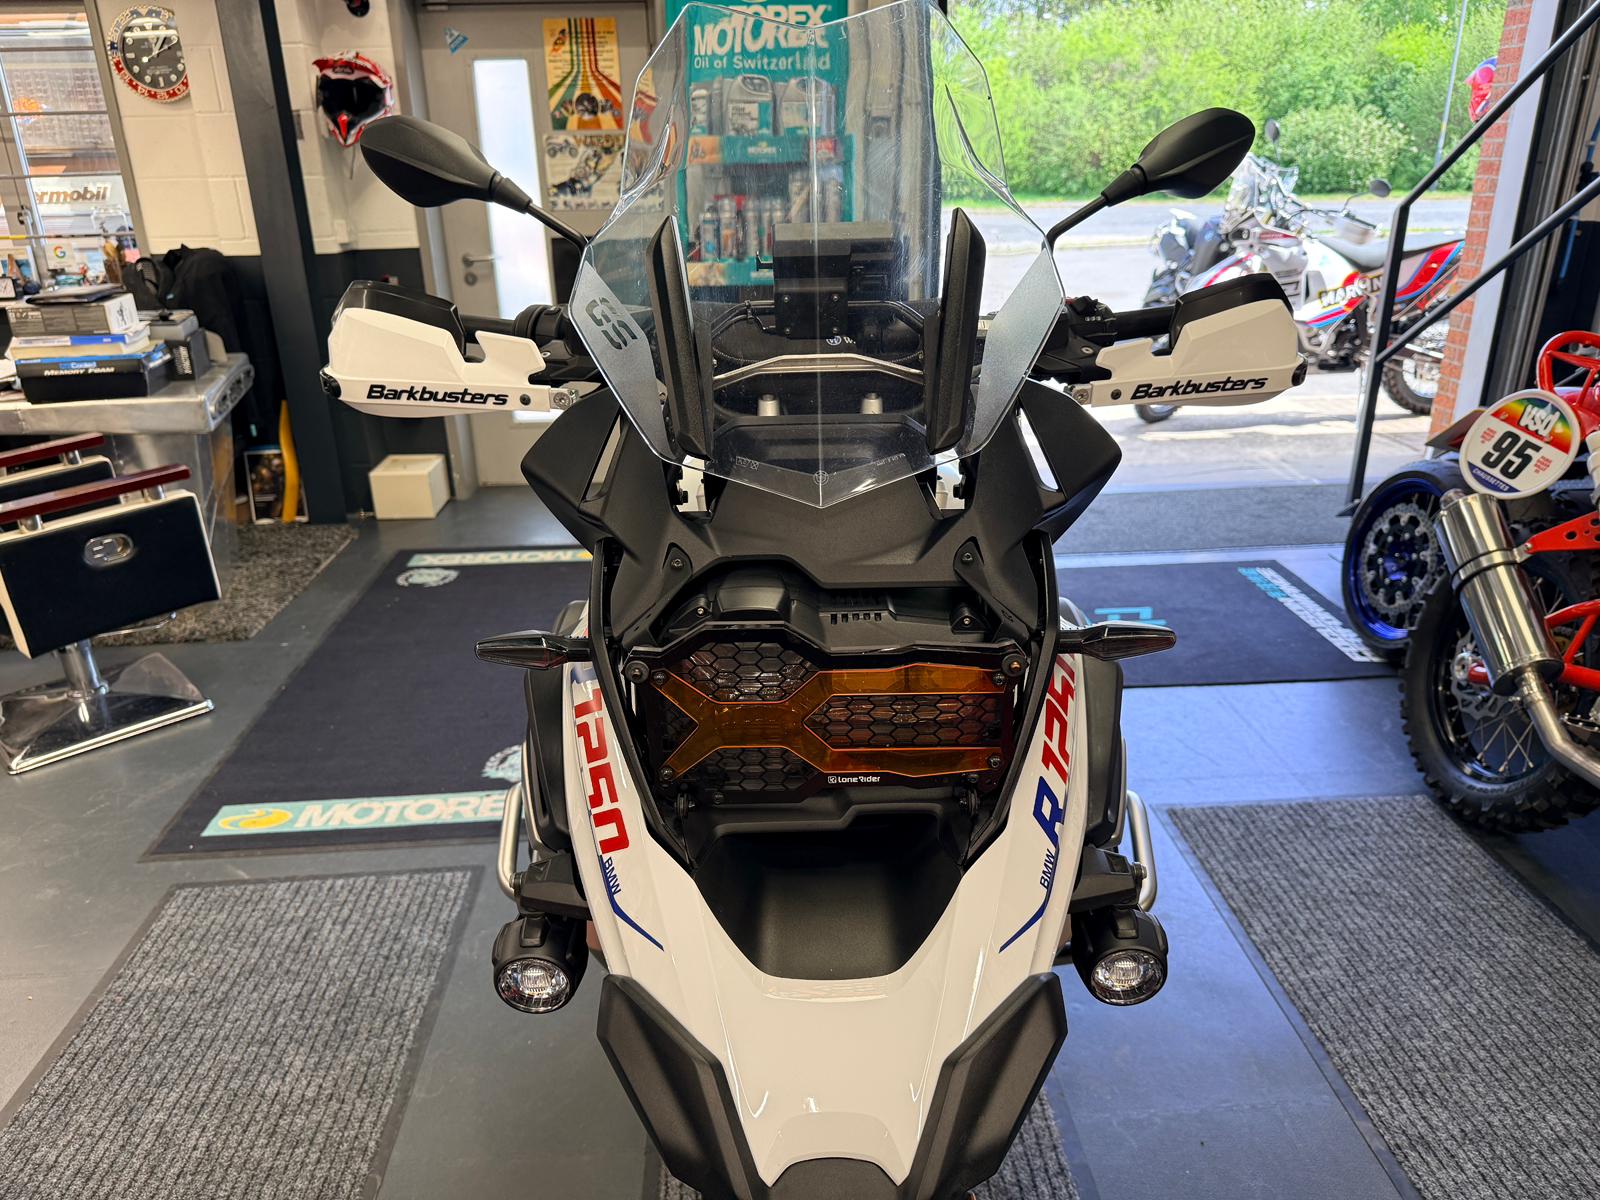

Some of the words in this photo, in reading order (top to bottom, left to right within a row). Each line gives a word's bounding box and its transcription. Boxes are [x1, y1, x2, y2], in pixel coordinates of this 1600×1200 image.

[694, 5, 829, 56] MOTOREX
[694, 56, 709, 69] Oil
[714, 56, 727, 68] of
[585, 297, 638, 350] GS
[367, 384, 509, 405] Barkbusters
[1130, 376, 1268, 400] Barkbusters
[1481, 430, 1543, 480] 95
[294, 796, 504, 828] MOTORE
[1032, 776, 1065, 848] R
[603, 856, 622, 896] BMW
[1039, 848, 1056, 890] BMW
